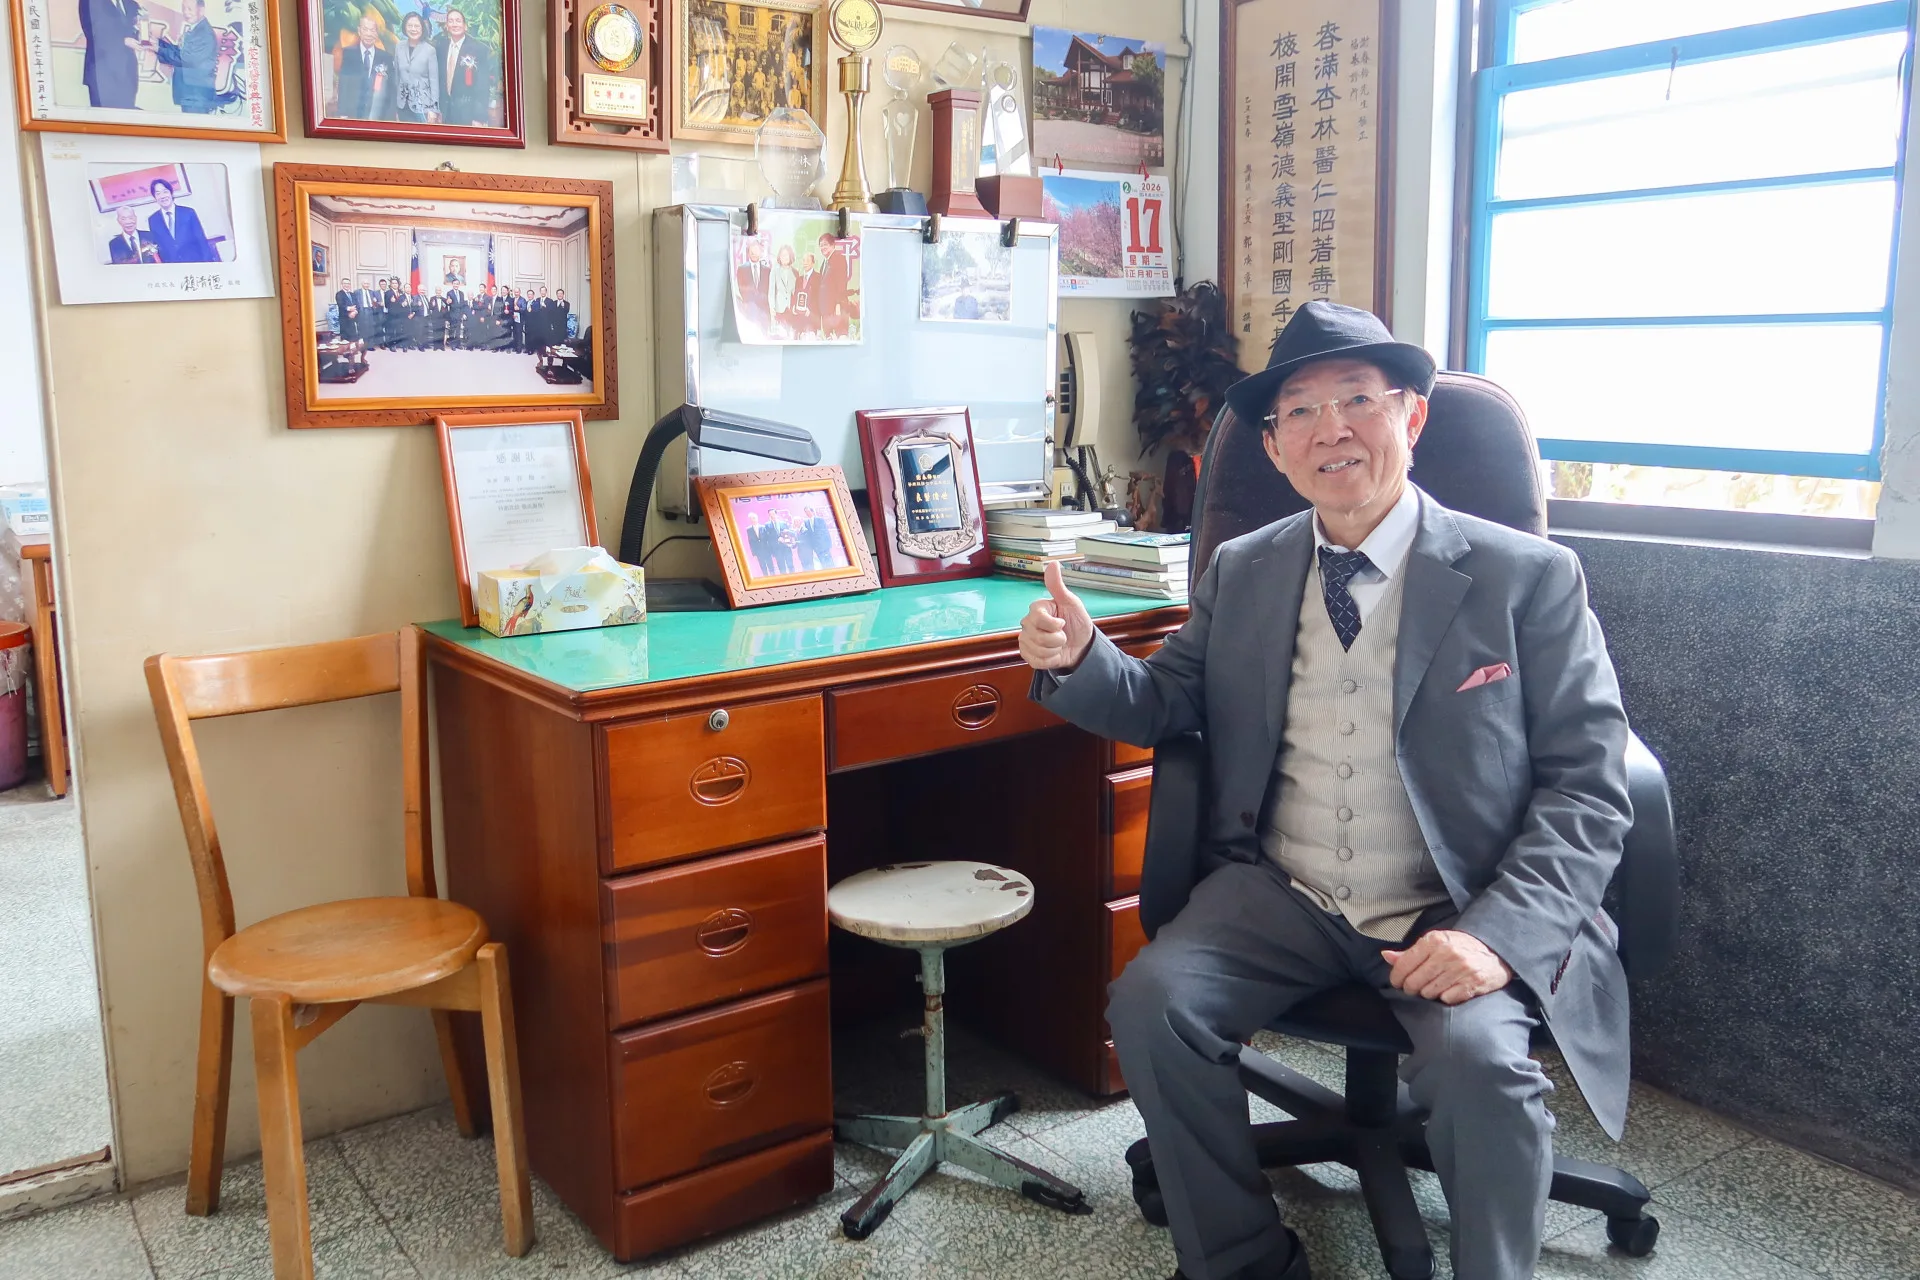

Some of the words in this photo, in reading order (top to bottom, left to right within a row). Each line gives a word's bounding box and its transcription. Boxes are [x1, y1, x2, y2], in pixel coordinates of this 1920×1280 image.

[29, 0, 48, 120] 民國九十七年十一月十二日
[1308, 20, 1343, 302] 春滿杏林醫仁昭著壽
[1142, 183, 1161, 191] 2026
[1126, 197, 1164, 253] 17
[1129, 255, 1162, 266] 星期二
[1130, 269, 1169, 279] 正月初一日
